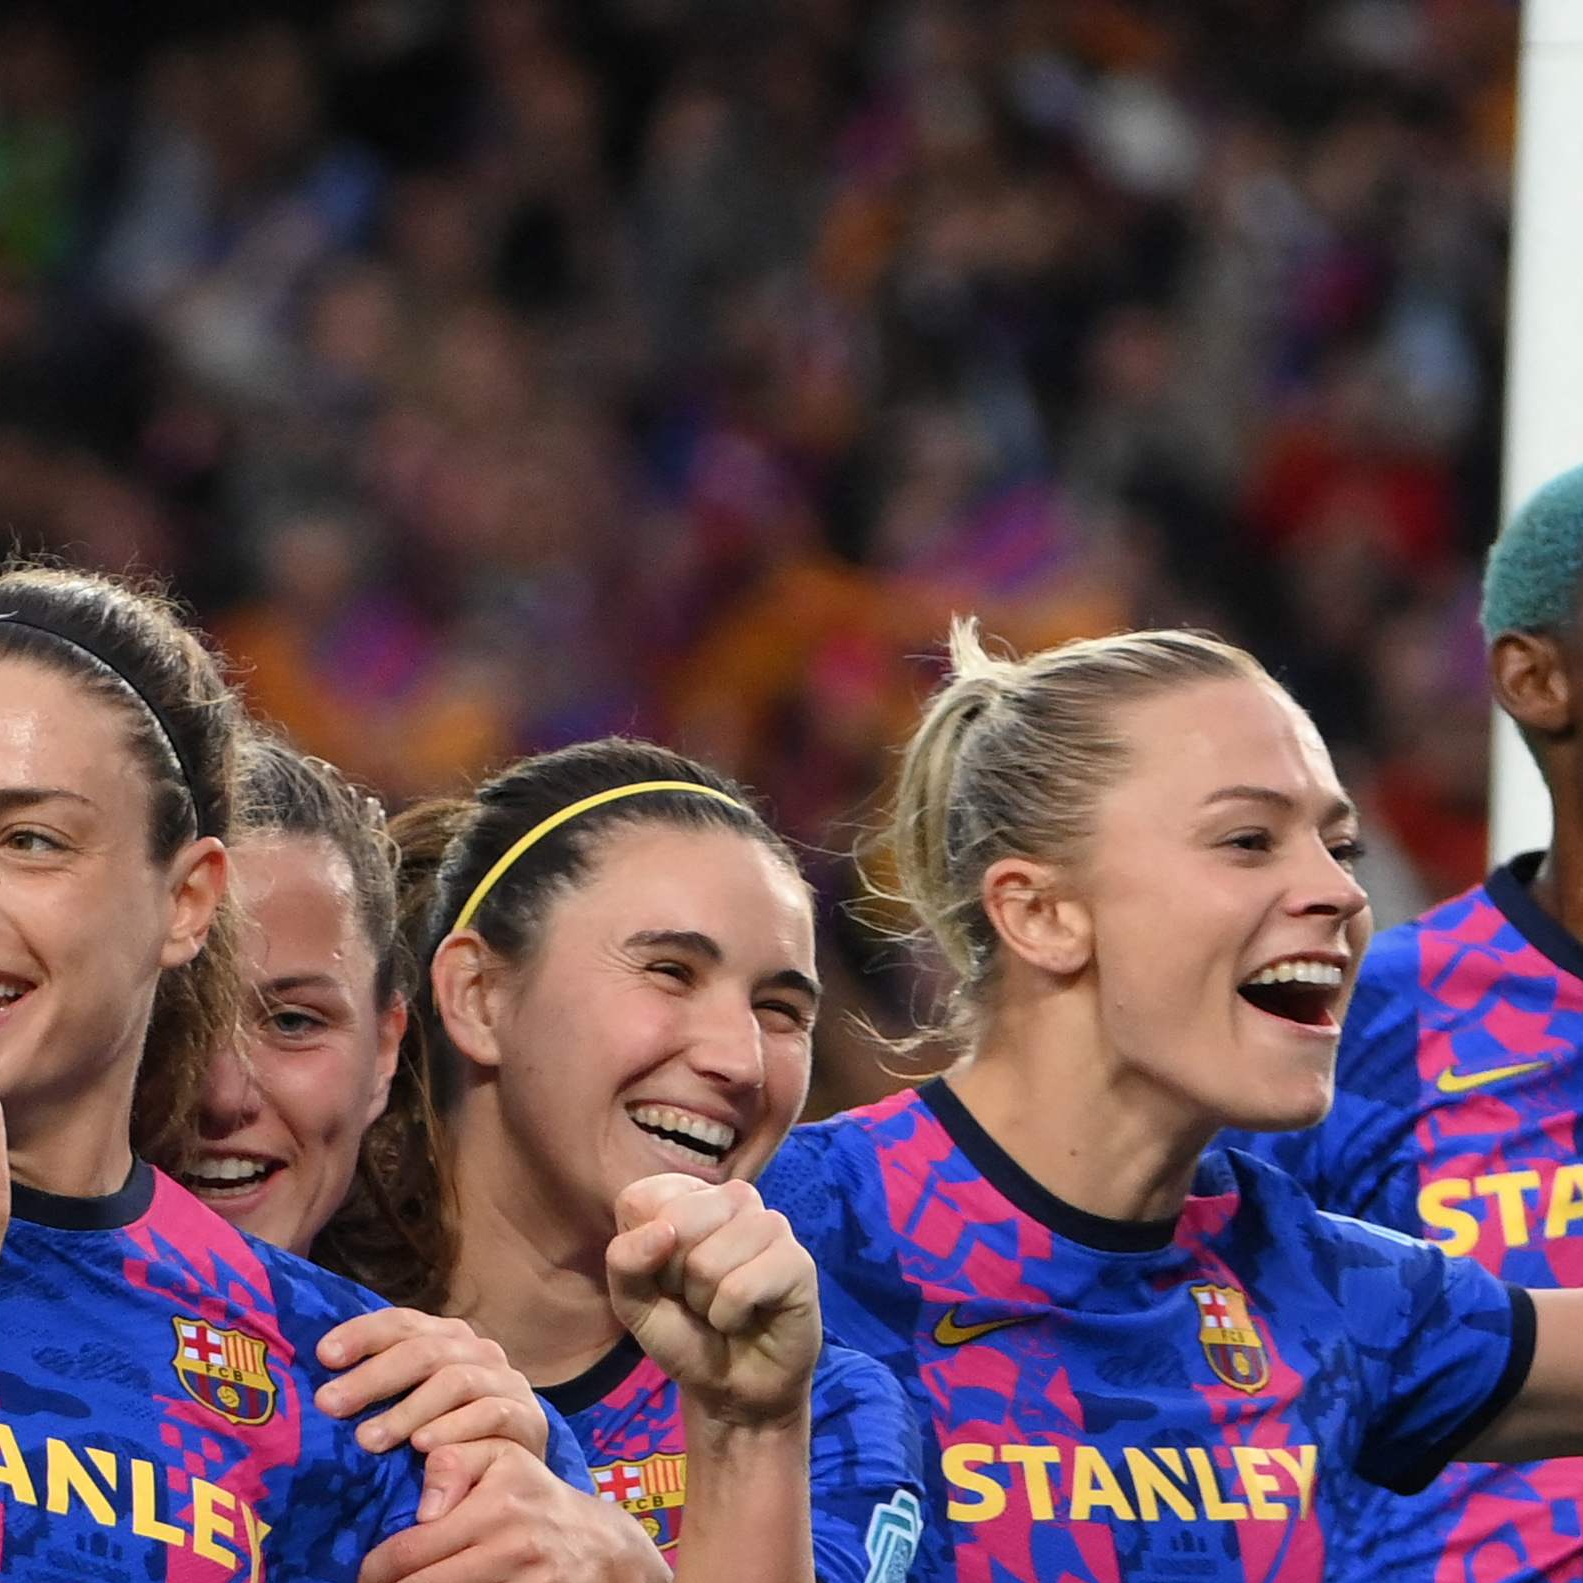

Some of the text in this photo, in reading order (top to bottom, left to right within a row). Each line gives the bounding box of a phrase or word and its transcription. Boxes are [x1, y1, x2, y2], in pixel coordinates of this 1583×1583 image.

[205, 1363, 244, 1382] FCB
[941, 1443, 1317, 1523] STANLEY
[622, 1495, 665, 1511] FCB
